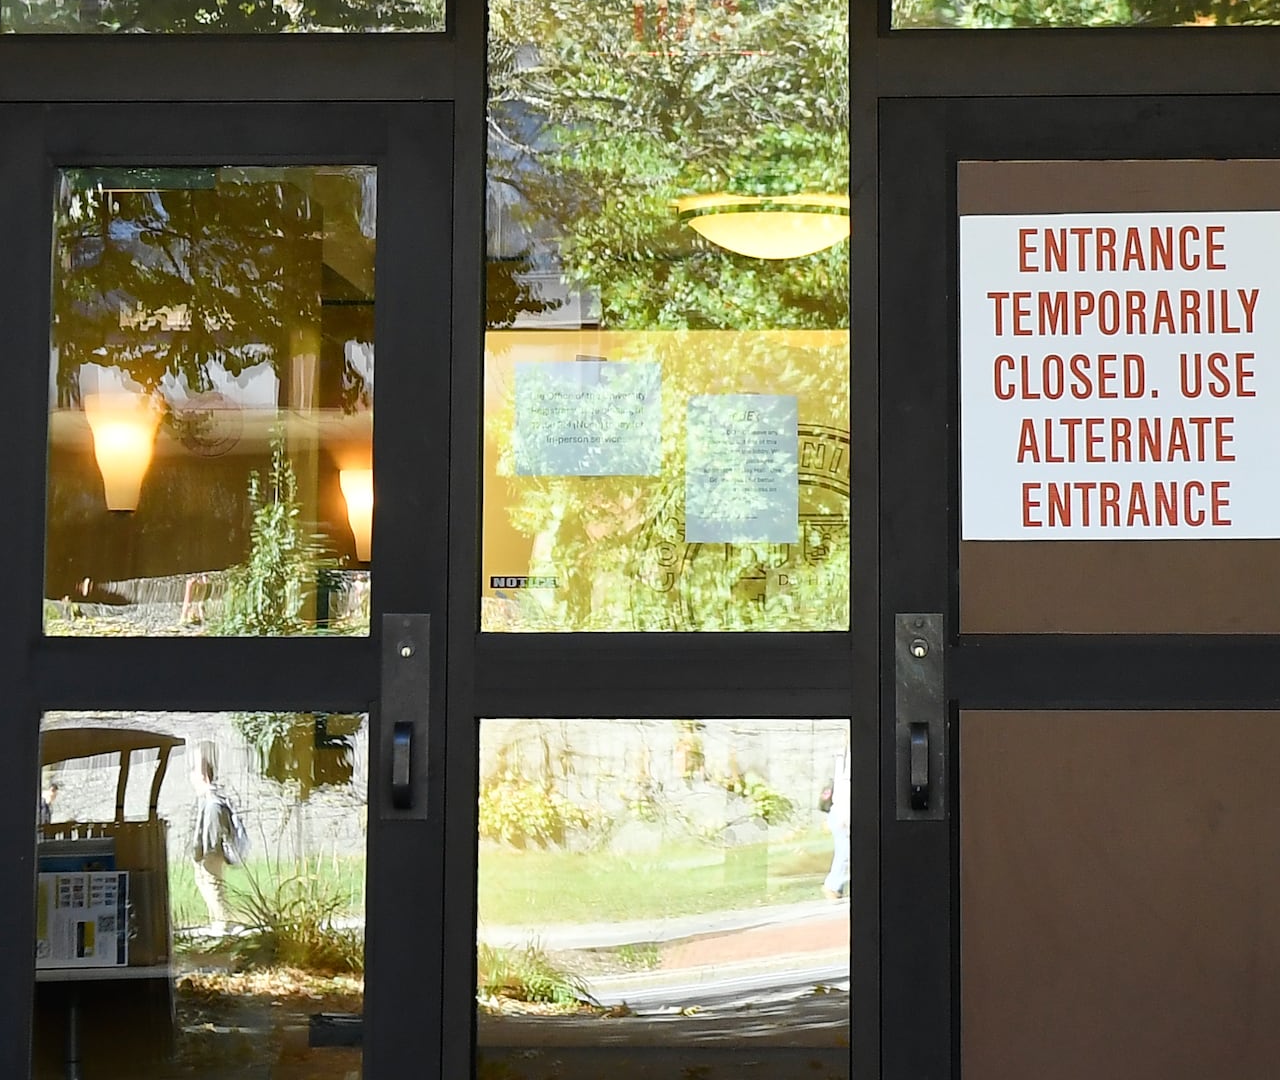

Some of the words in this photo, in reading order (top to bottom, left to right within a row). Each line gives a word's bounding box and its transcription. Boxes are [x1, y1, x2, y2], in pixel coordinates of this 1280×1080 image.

[1019, 225, 1227, 273] ENTRANCE
[987, 289, 1260, 336] TEMPORARILY
[994, 353, 1159, 400] CLOSED.
[1180, 352, 1257, 399] USE
[1017, 417, 1236, 463] ALTERNATE
[1022, 481, 1232, 528] ENTRANCE
